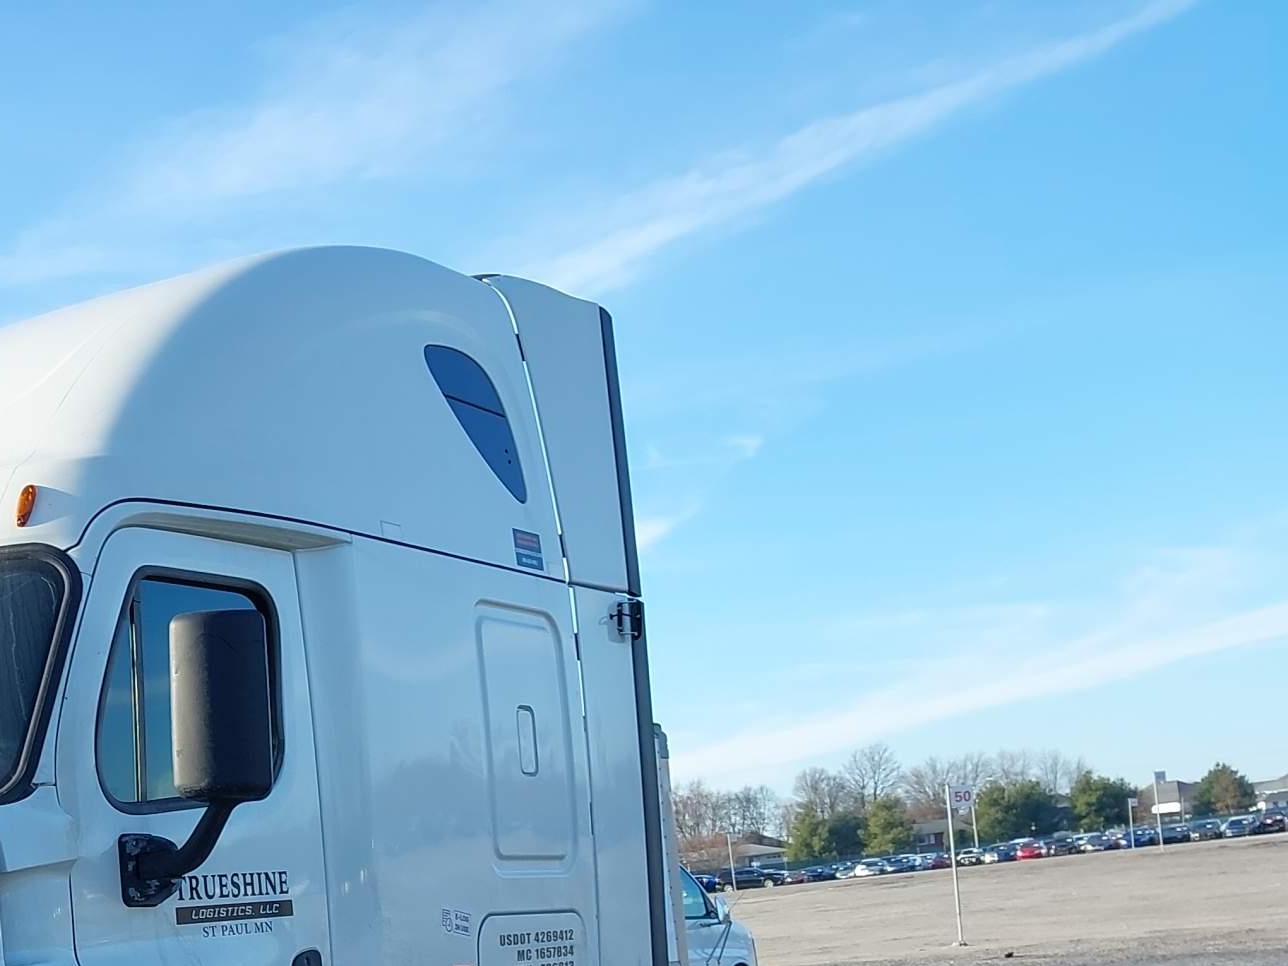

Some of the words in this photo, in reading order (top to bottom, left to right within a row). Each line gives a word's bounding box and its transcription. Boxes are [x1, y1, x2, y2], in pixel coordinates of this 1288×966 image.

[954, 790, 971, 802] 50
[177, 871, 289, 901] TRUESHINE
[260, 904, 279, 914] LLC
[202, 926, 217, 938] ST
[221, 923, 251, 936] PAUL
[254, 921, 273, 933] MN
[500, 933, 532, 947] USDOT
[534, 929, 575, 943] 4269412
[517, 949, 532, 961] MC
[535, 945, 575, 959] 1657834
